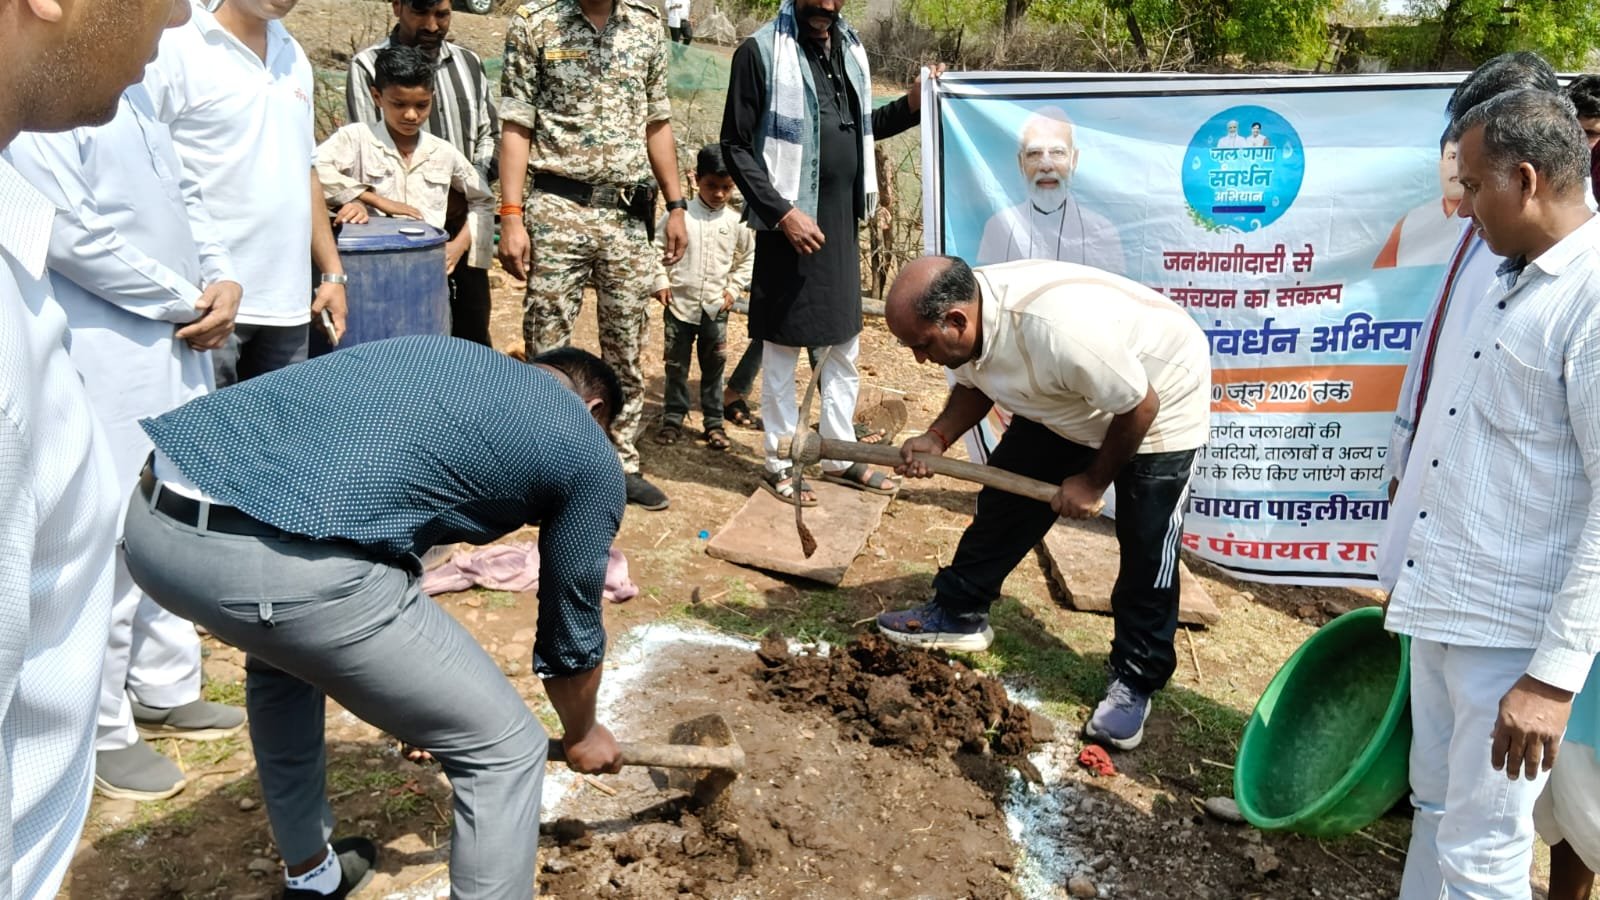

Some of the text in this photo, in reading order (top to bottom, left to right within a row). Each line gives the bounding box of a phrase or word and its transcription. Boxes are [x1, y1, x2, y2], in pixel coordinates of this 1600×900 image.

[1211, 147, 1239, 161] जल
[1210, 163, 1273, 187] संवर्धन
[1163, 243, 1314, 275] जनभागीदारी से
[1169, 280, 1344, 309] संचयन का संकल्प
[1211, 381, 1352, 408] 0 जून 2026 तक
[1209, 421, 1342, 440] तर्गत जलाशयों की
[1210, 442, 1261, 462] नदियों,
[1263, 443, 1321, 461] तालाबों
[1321, 446, 1335, 461] व
[1338, 446, 1374, 461] अन्य
[1211, 463, 1229, 481] के
[1232, 463, 1263, 481] लिए
[1266, 463, 1299, 481] किए
[1302, 463, 1347, 481] जाएंगे
[1350, 463, 1386, 481] कार्य
[1206, 532, 1330, 561] पंचायत
